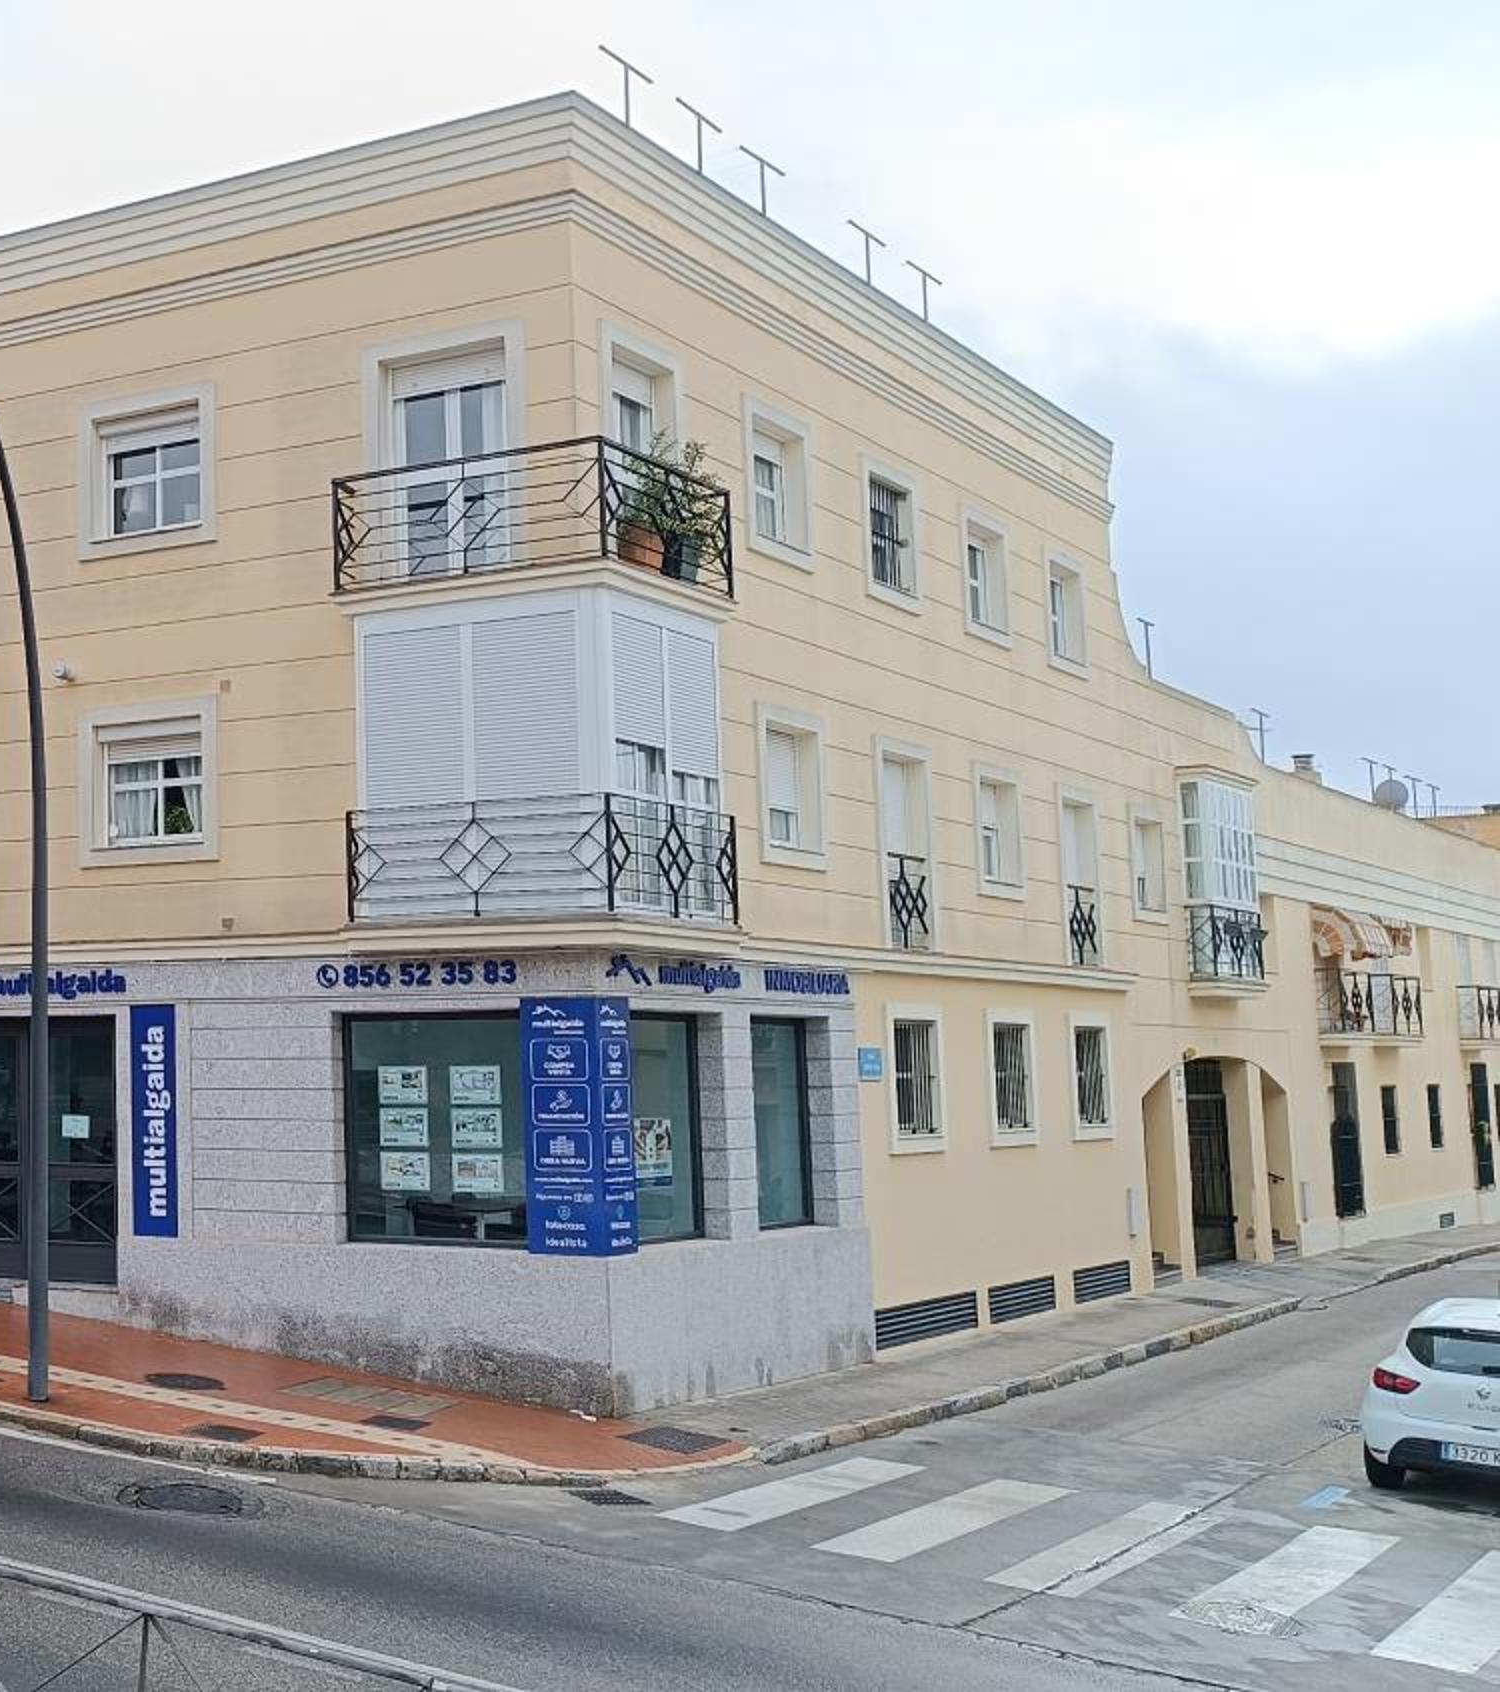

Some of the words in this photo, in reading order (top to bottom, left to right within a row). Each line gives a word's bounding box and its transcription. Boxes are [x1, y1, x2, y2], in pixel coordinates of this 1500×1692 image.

[343, 963, 391, 988] 856
[399, 962, 432, 986] 52
[440, 961, 474, 985] 35
[483, 959, 517, 985] 83
[141, 1025, 171, 1217] multialgaida
